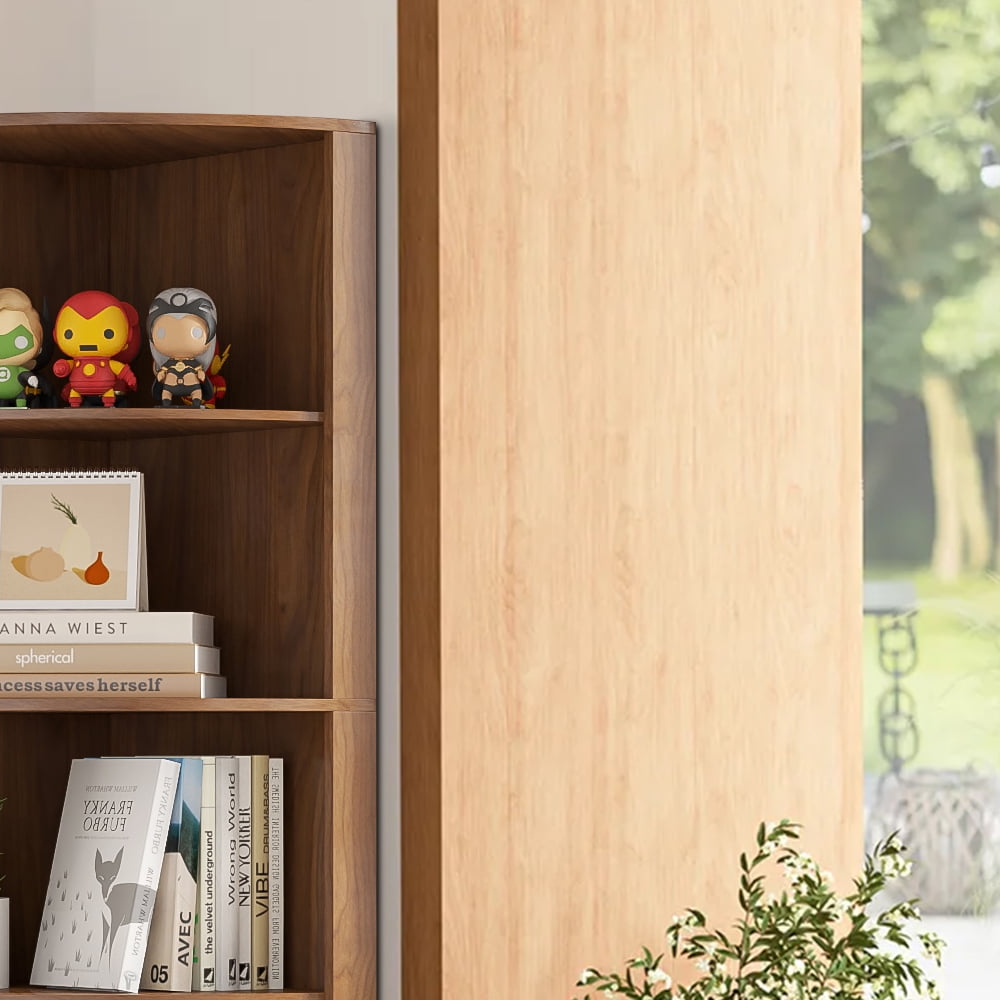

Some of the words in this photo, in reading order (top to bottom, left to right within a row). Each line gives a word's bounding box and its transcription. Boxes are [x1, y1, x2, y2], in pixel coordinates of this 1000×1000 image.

[68, 622, 129, 635] WIEST
[15, 648, 74, 667] spherical
[45, 681, 95, 692] saves
[97, 678, 163, 693] herself
[228, 772, 236, 832] World
[238, 806, 251, 867] YORKER
[205, 830, 215, 900] underground
[228, 839, 237, 905] Wrong
[238, 871, 251, 907] NEW
[255, 862, 269, 918] VIBE
[205, 903, 213, 934] velvet
[177, 912, 192, 966] AVEC
[205, 937, 213, 954] the
[150, 965, 169, 983] 05
